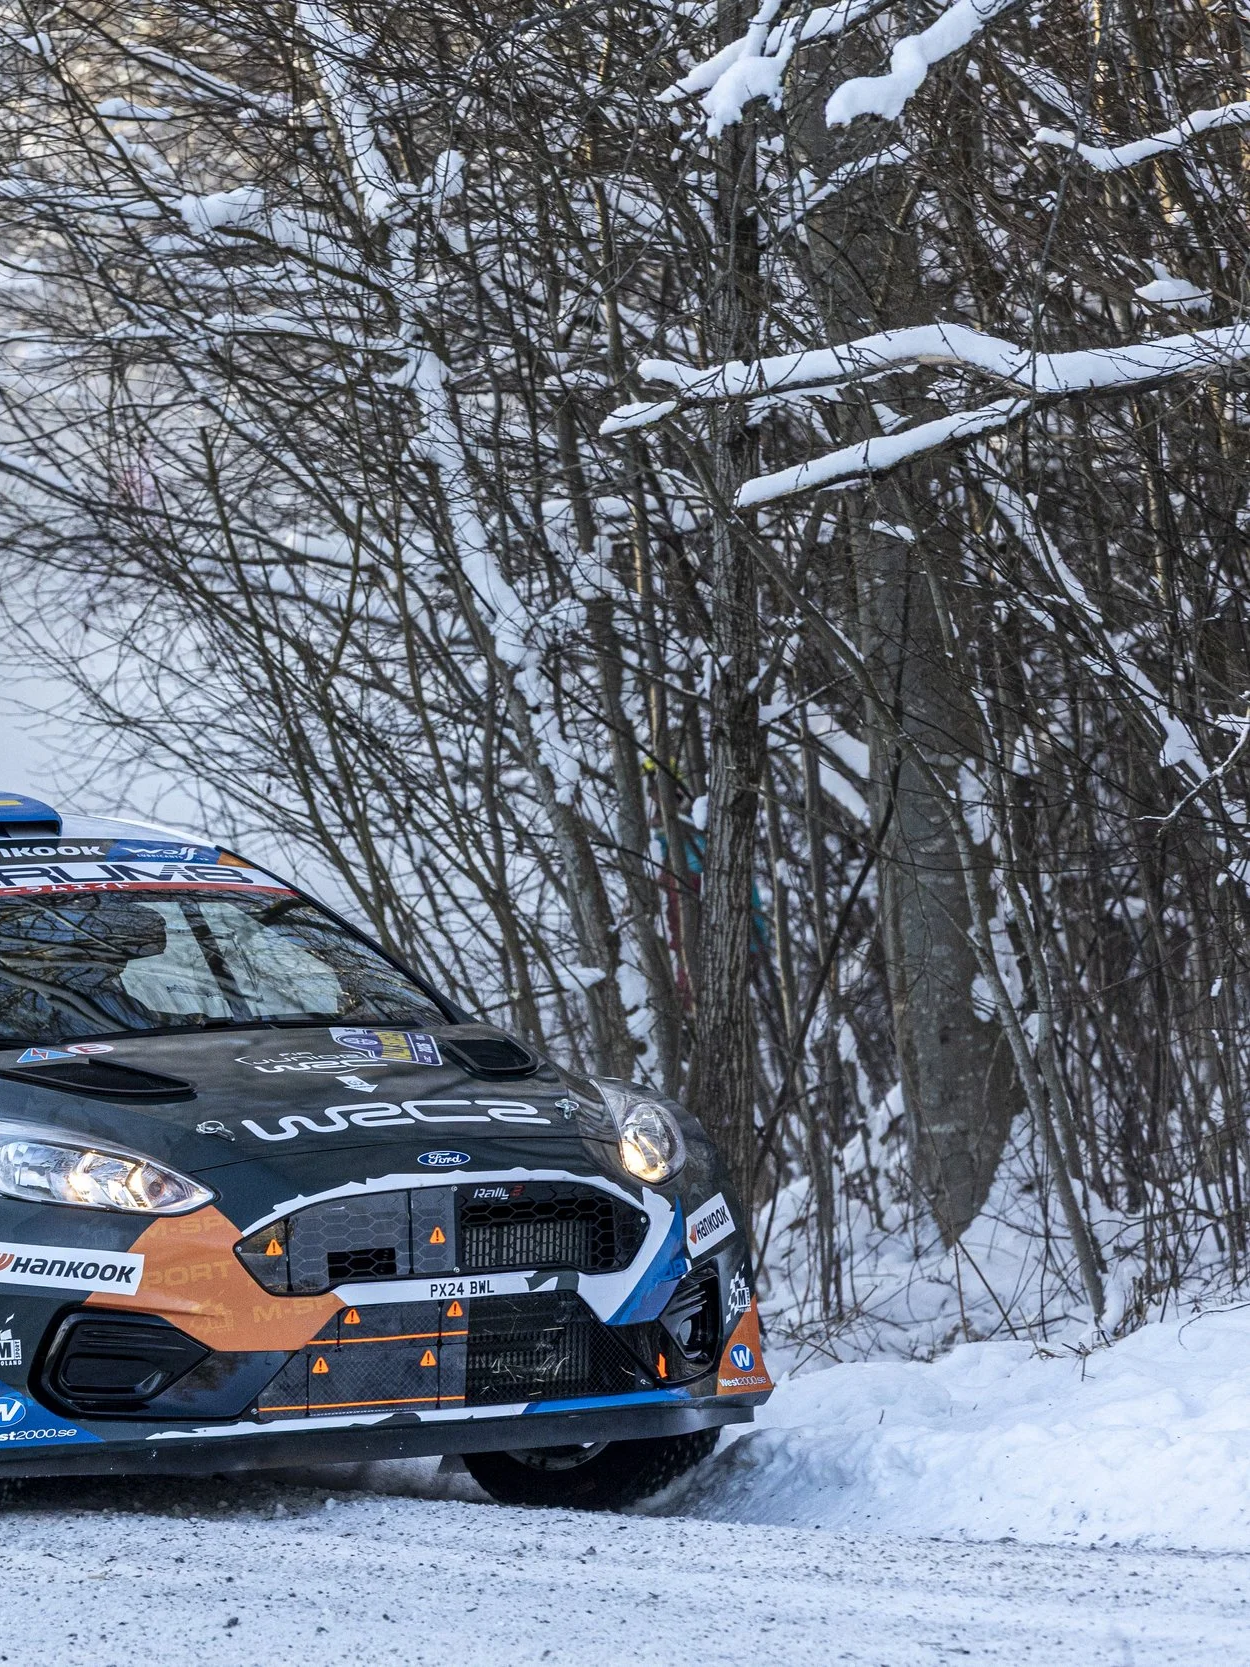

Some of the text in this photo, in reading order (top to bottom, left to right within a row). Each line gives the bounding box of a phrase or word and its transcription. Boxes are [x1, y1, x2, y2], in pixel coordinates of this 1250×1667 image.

[427, 1152, 463, 1167] Ford
[430, 1280, 495, 1298] PX24 BWL
[718, 1375, 767, 1388] West2000.se
